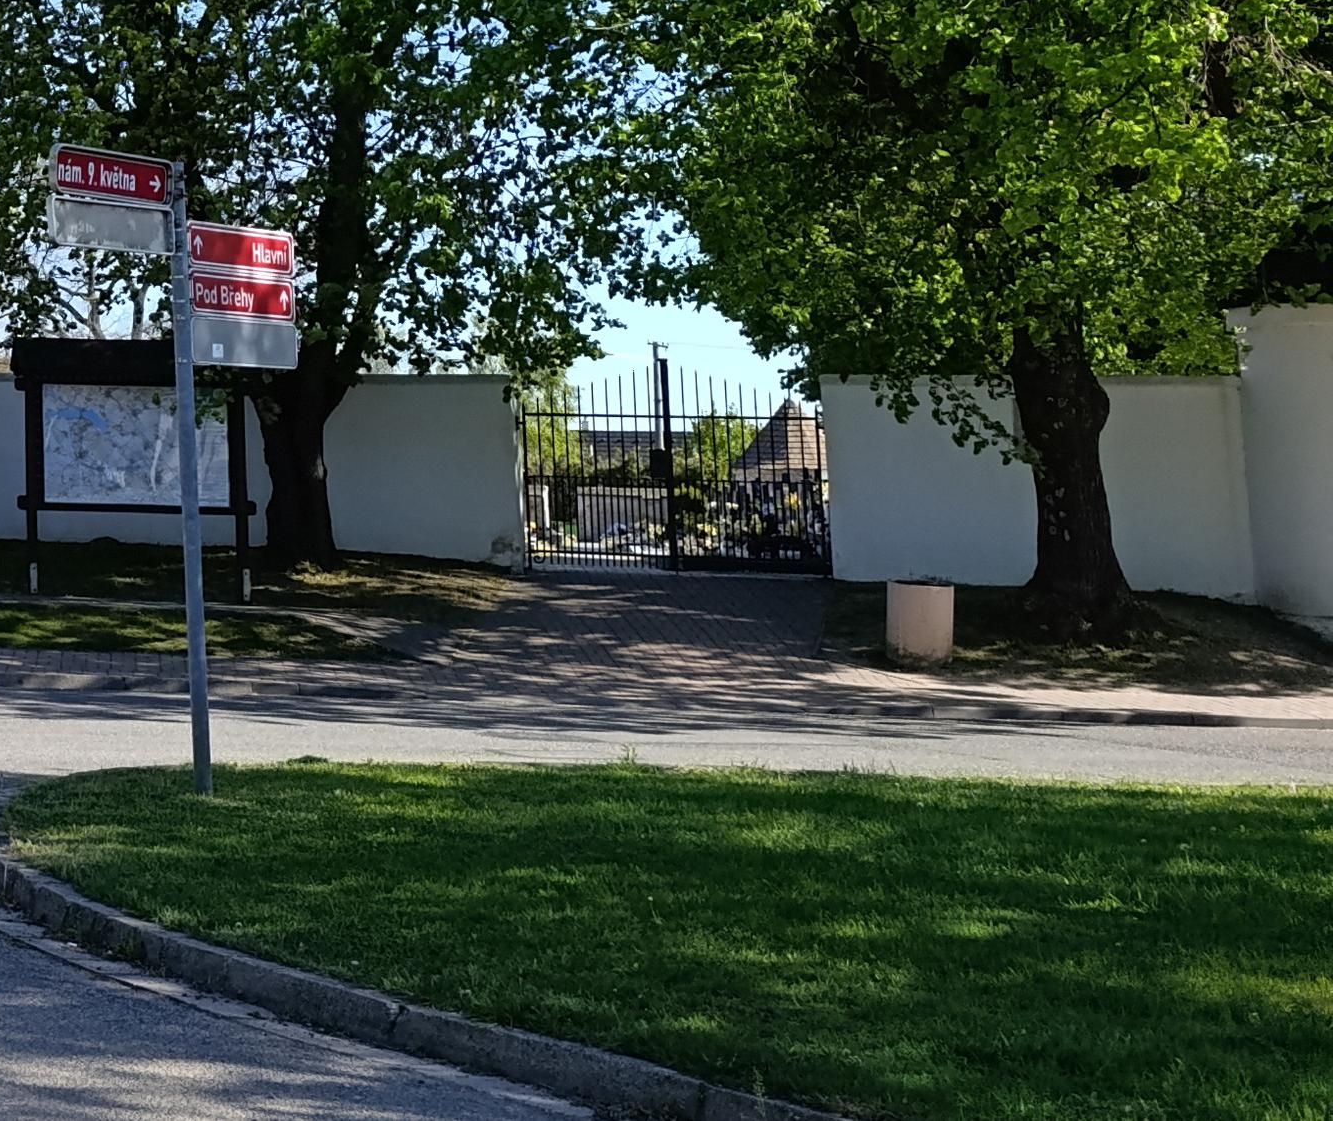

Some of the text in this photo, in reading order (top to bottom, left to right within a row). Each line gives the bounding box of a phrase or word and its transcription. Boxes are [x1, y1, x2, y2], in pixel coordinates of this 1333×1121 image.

[58, 159, 136, 192] nám. 9. května
[252, 243, 287, 264] Hlavní
[195, 282, 254, 312] Pod Břehy
